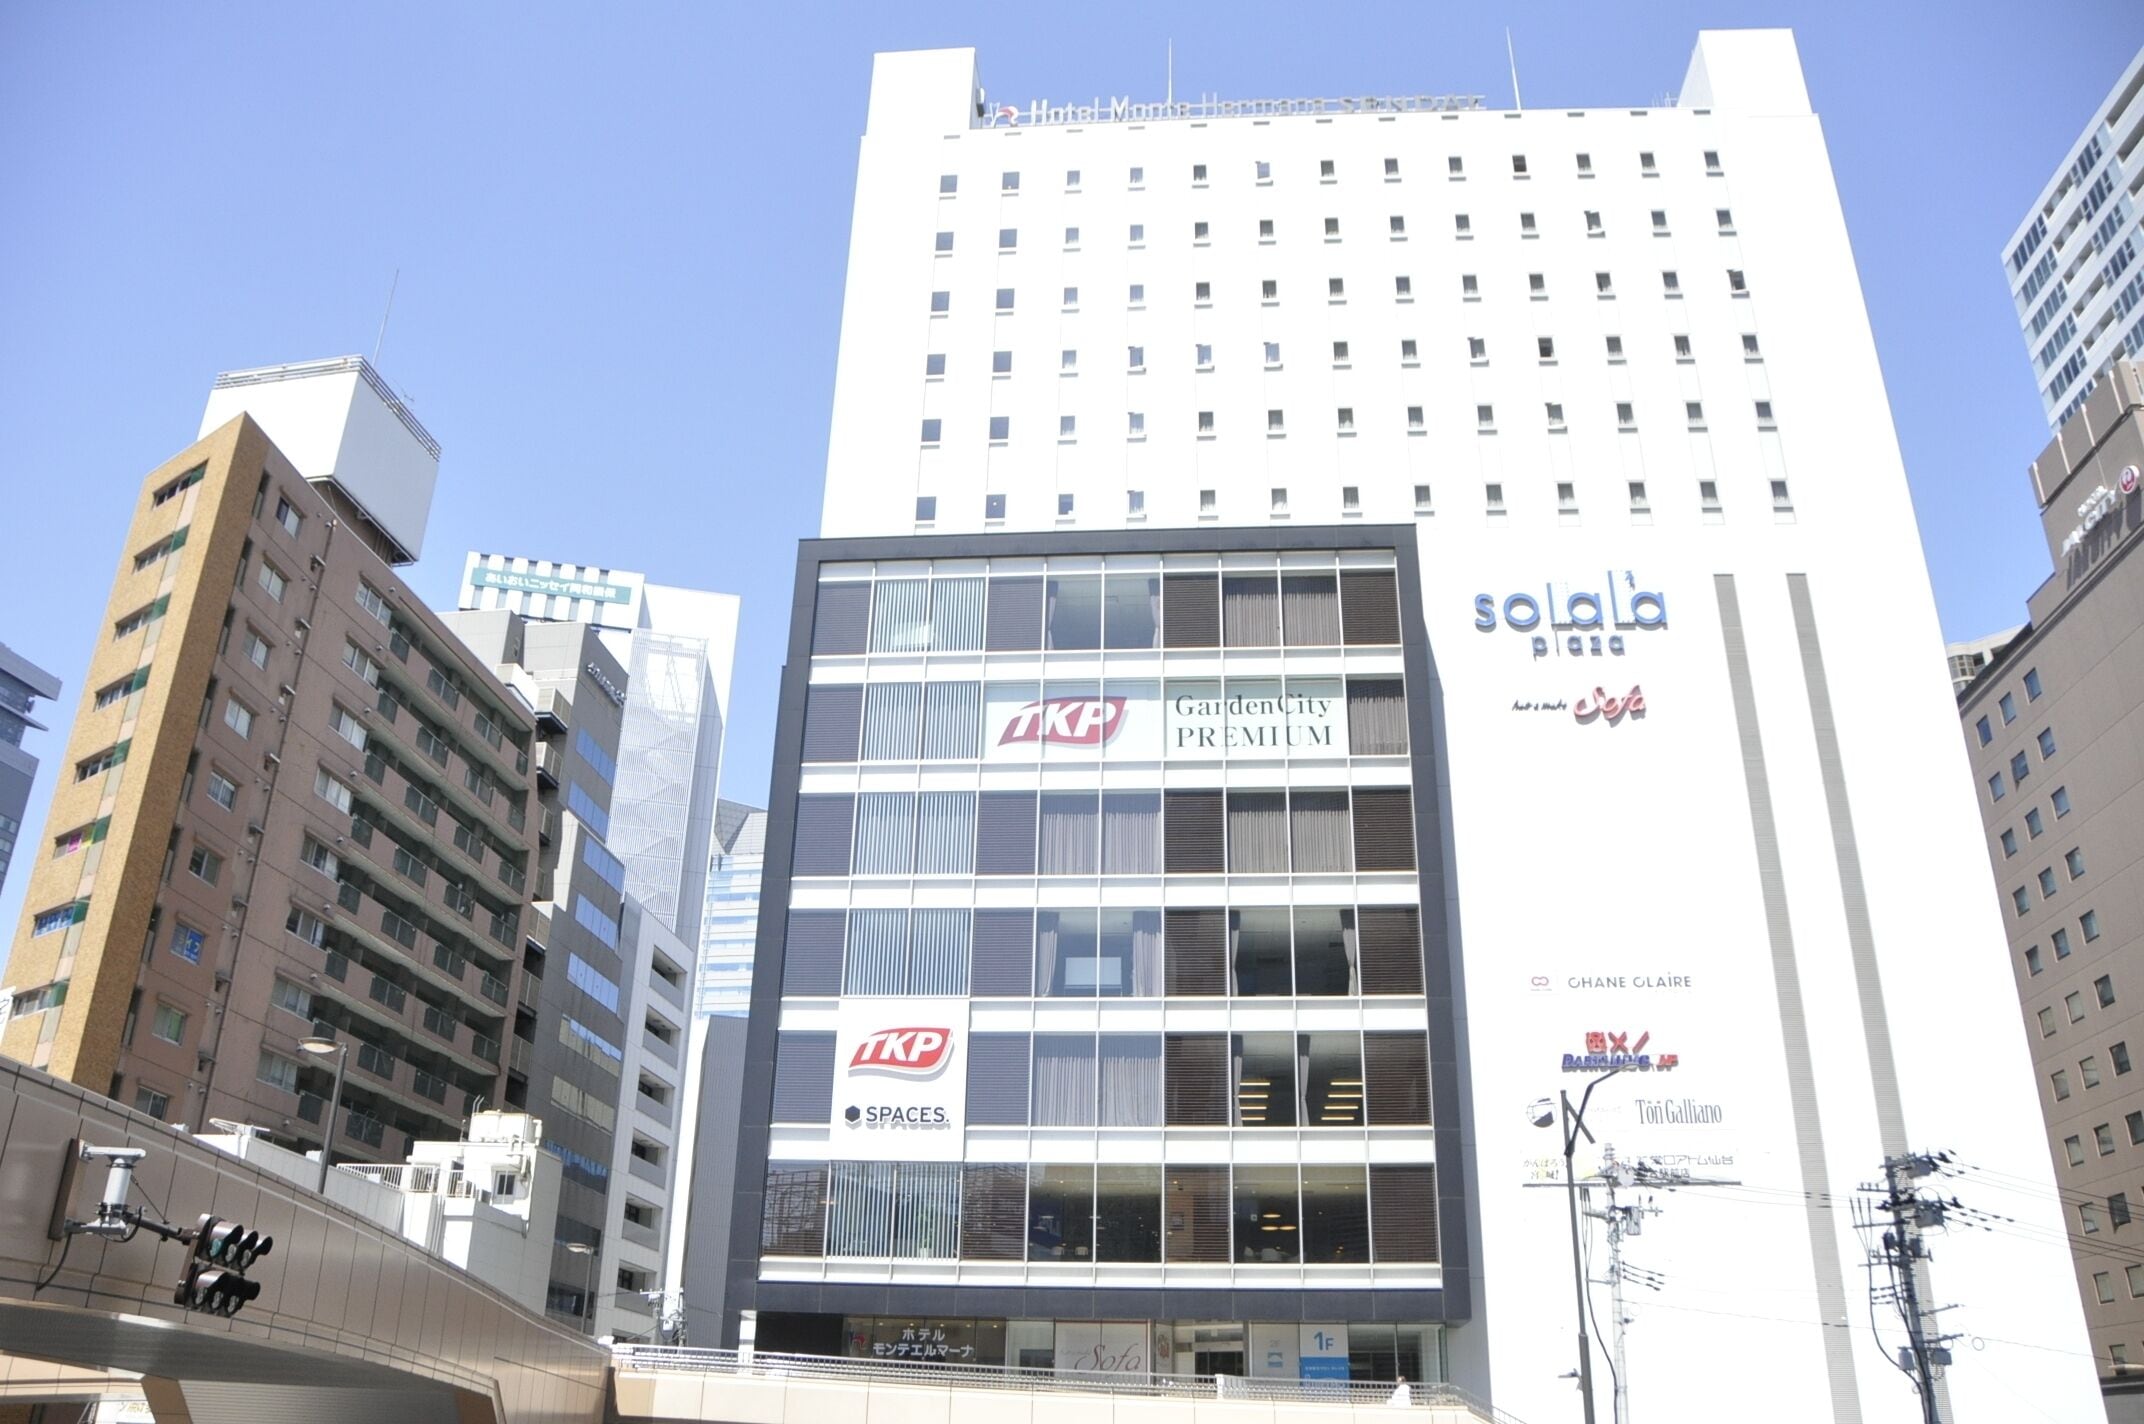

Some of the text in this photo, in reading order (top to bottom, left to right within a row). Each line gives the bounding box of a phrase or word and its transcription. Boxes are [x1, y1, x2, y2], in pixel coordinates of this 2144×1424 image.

[1030, 96, 1099, 126] Hotel
[1110, 94, 1190, 123] Monte
[1531, 633, 1626, 662] plaza
[1013, 699, 1117, 739] TKP
[1176, 725, 1333, 749] PREMIUM
[1567, 975, 1627, 989] CHANE
[859, 1031, 943, 1062] TKP
[1664, 1097, 1723, 1125] Galliano
[902, 1328, 946, 1342] ホテル
[1312, 1331, 1334, 1351] 1F
[873, 1342, 975, 1359] モンテエルマーナ
[1073, 1342, 1142, 1373] Sofa
